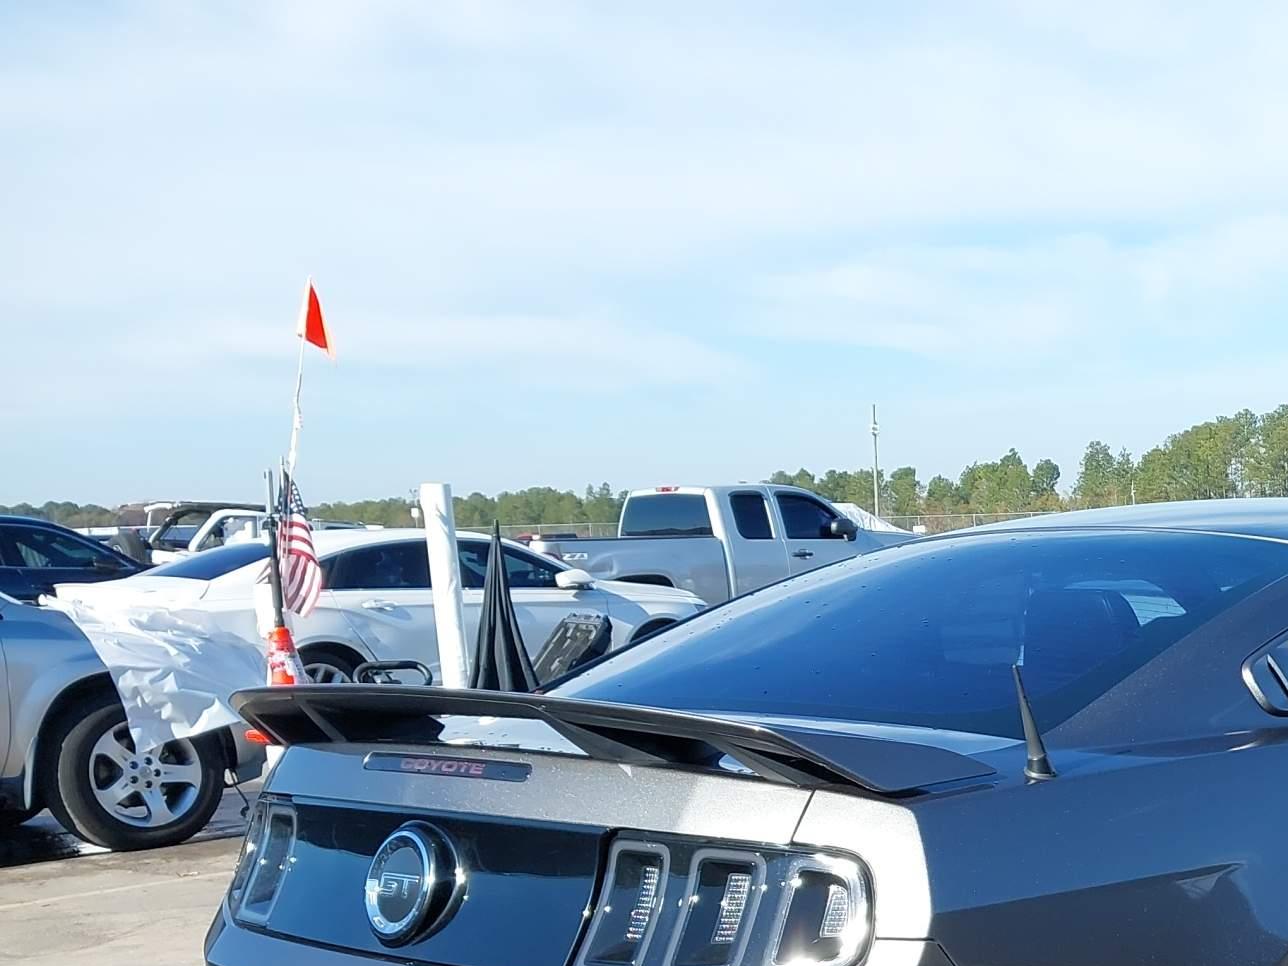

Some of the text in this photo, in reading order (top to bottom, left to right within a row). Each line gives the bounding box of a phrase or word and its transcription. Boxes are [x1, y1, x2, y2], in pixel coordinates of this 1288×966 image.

[561, 551, 588, 561] Z71
[400, 757, 486, 775] COYOTE
[379, 871, 420, 899] GT
